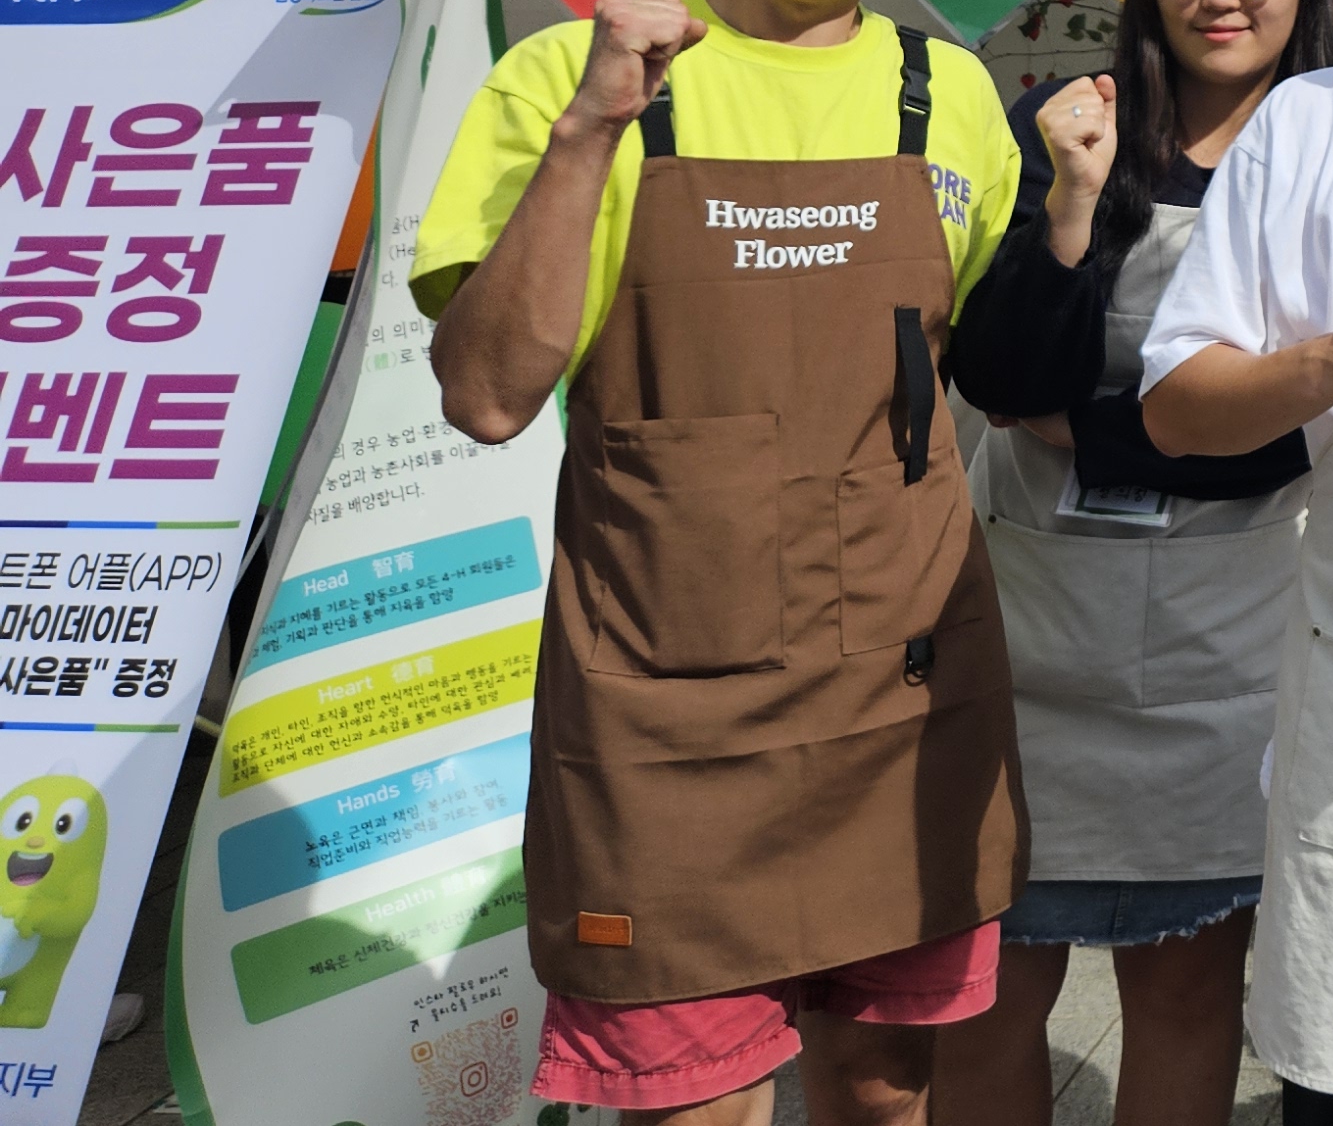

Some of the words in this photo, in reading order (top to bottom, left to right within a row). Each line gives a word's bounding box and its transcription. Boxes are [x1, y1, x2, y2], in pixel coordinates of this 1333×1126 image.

[0, 100, 322, 209] 사은품
[705, 199, 880, 232] Hwaseong
[733, 238, 854, 270] Flower
[0, 233, 226, 344] 증정
[351, 435, 382, 457] 경우
[386, 425, 417, 448] 농업
[325, 466, 367, 492] 농업과
[370, 449, 446, 480] 농촌사회를
[347, 480, 425, 514] 배양합니다.
[67, 552, 222, 592] 어플(APP)
[302, 568, 350, 597] Head
[326, 595, 361, 614] 기르는
[363, 580, 412, 603] 활동으로
[415, 574, 440, 590] 모든
[0, 603, 159, 644] 마이데이터
[321, 613, 359, 634] 판단을
[112, 658, 178, 699] 증정
[317, 675, 375, 704] Heart
[317, 705, 349, 724] 조직을
[353, 696, 376, 714] 향한
[272, 732, 306, 751] 자신에
[310, 725, 333, 739] 대한
[301, 742, 325, 757] 대한
[336, 783, 401, 815] Hands
[304, 830, 344, 853] 노육은
[348, 814, 388, 838] 근면과
[307, 838, 372, 869] 직업준비와
[375, 817, 440, 846] 직업능력을
[364, 886, 436, 923] Health
[308, 954, 351, 976] 체육은
